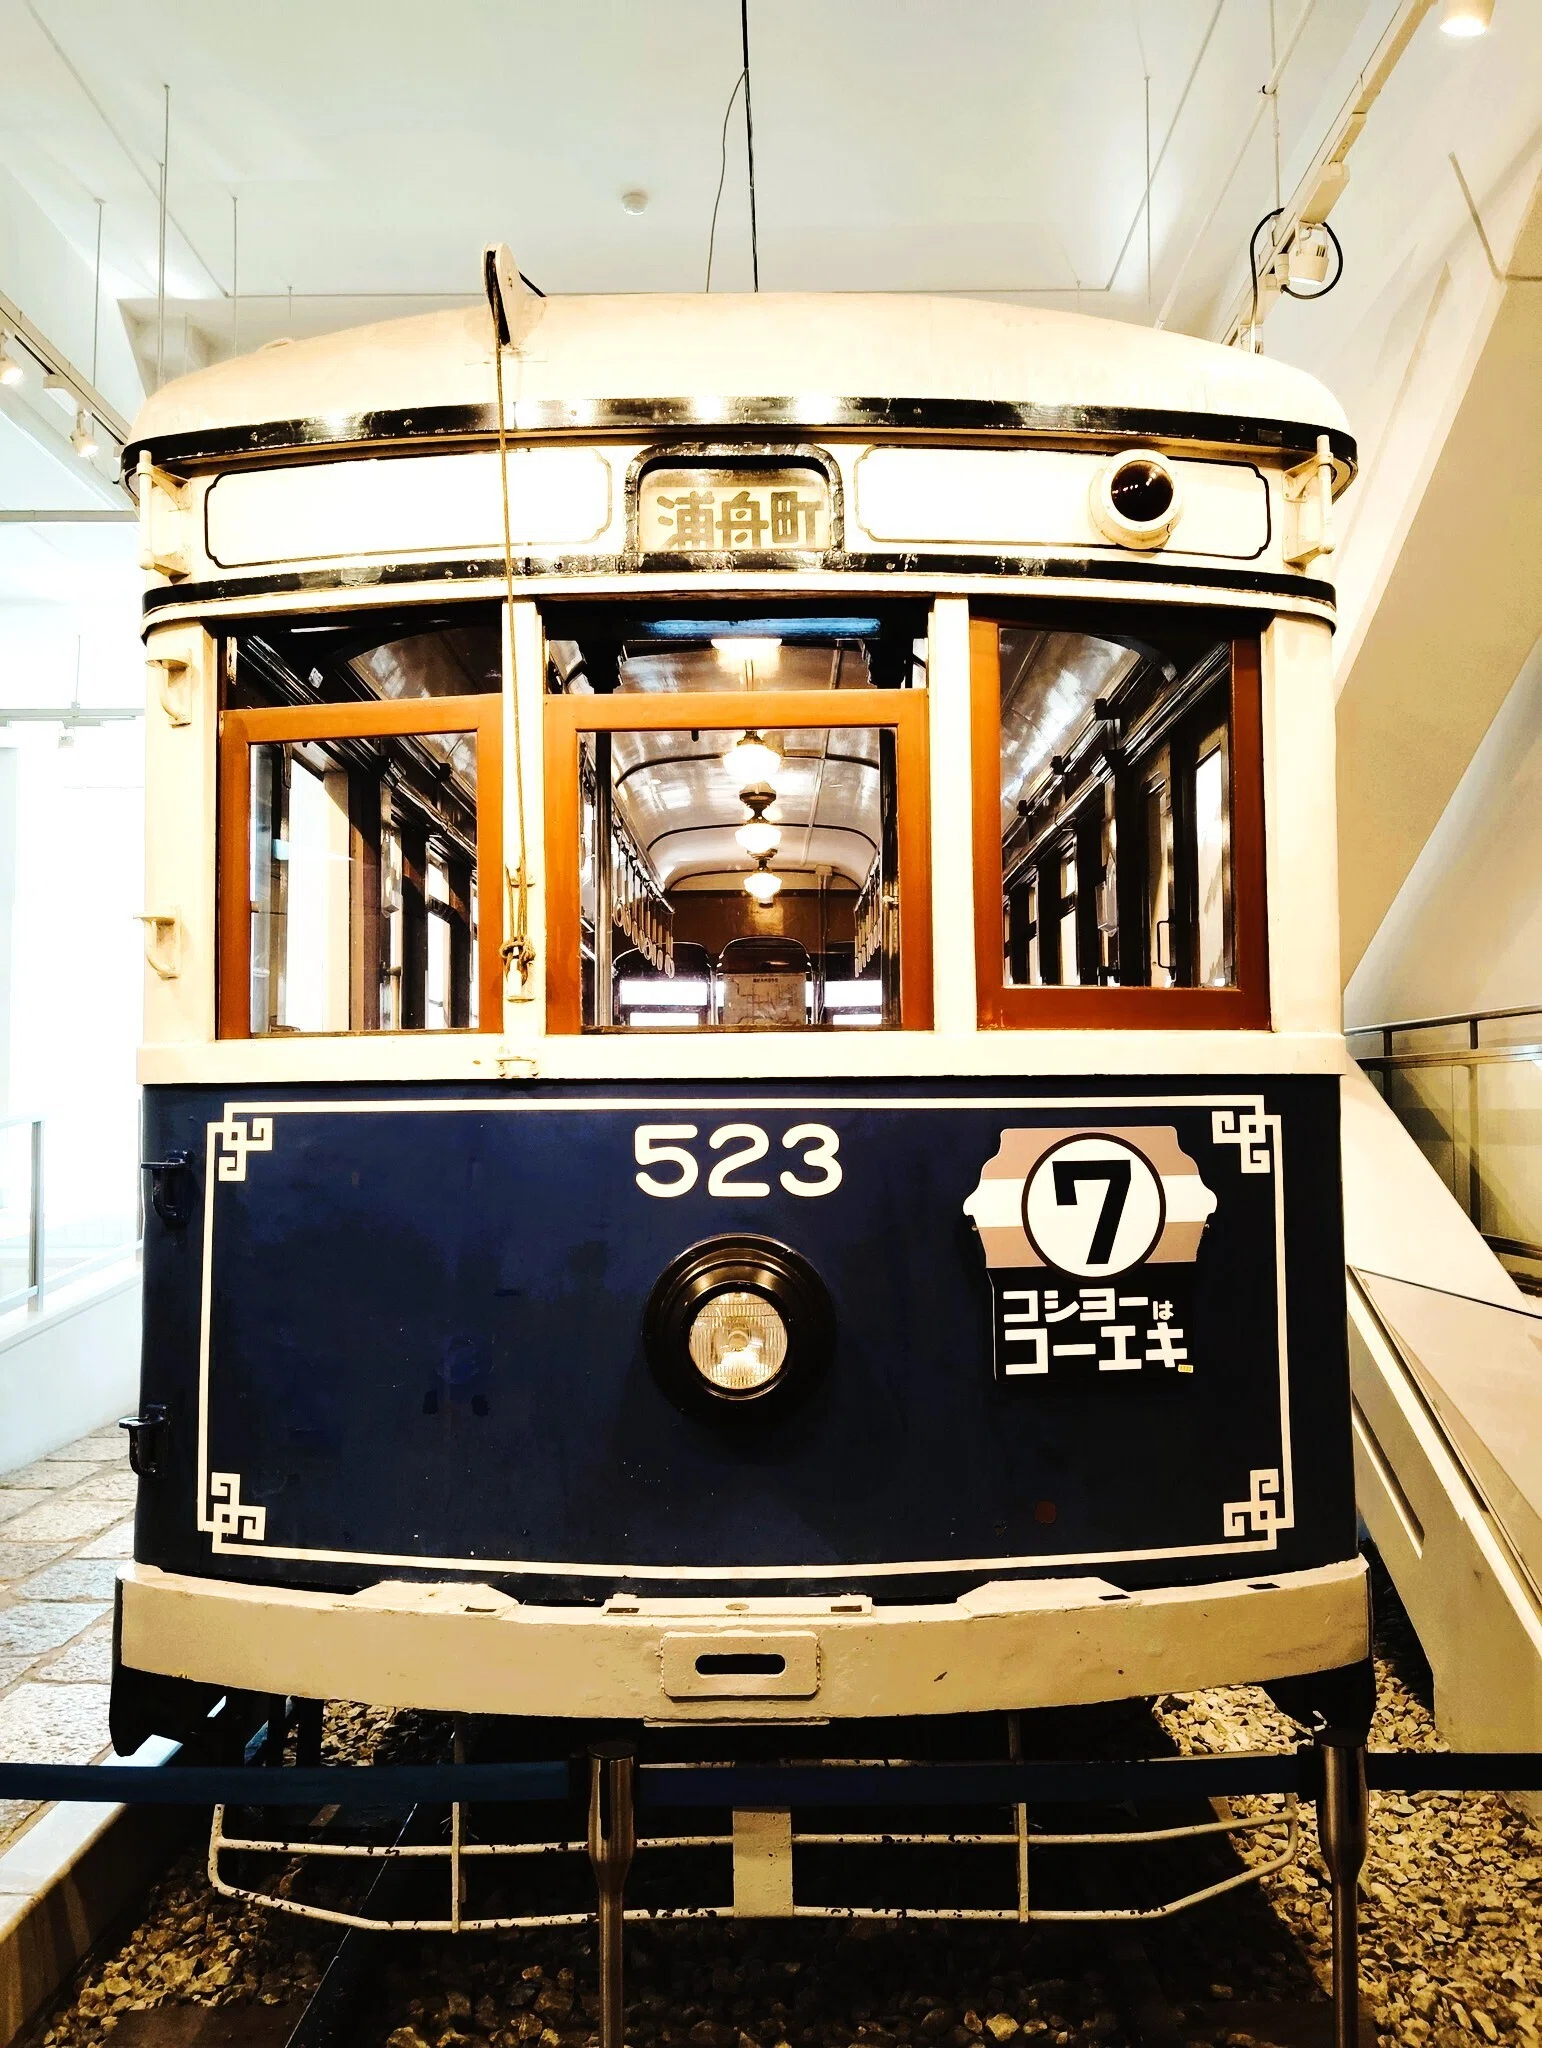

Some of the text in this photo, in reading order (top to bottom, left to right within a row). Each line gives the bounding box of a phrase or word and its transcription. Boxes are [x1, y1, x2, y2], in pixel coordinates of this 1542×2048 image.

[656, 490, 825, 550] 浦舟町
[634, 1123, 843, 1198] 523
[1052, 1159, 1132, 1265] 7
[1004, 1321, 1188, 1376] コーエキ
